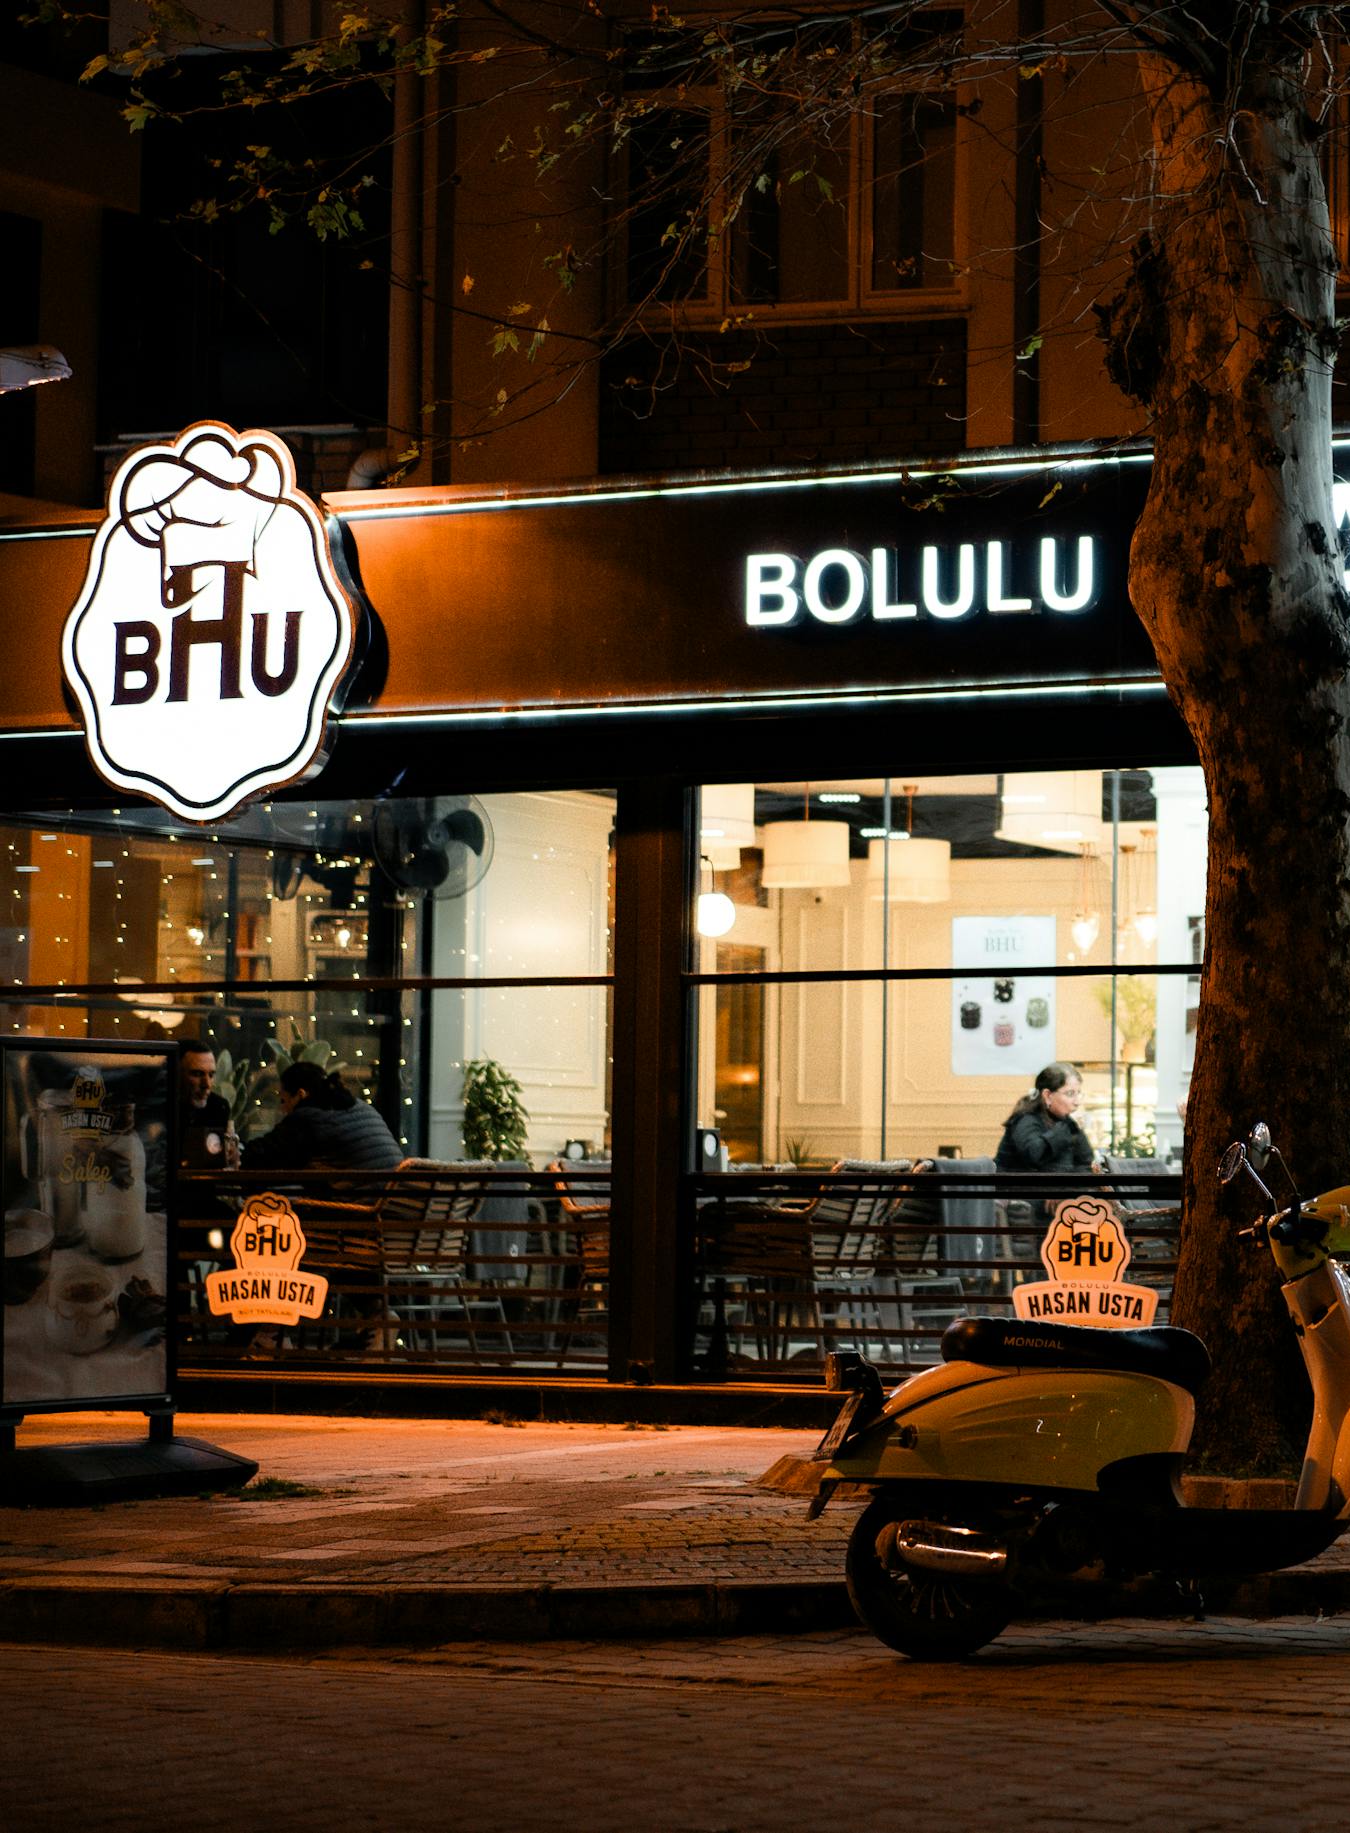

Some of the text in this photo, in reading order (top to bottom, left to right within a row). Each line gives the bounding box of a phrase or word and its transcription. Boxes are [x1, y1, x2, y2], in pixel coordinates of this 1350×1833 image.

[744, 535, 1096, 628] BOLULU
[110, 560, 304, 706] BHU
[76, 1080, 101, 1100] BHU
[245, 1225, 291, 1256] BHU
[1058, 1232, 1114, 1267] BHU
[218, 1279, 315, 1306] HASAN USTA
[1061, 1282, 1110, 1290] BOLULU
[1027, 1291, 1144, 1321] HASAN USTA
[1003, 1336, 1065, 1350] MONDIAL
